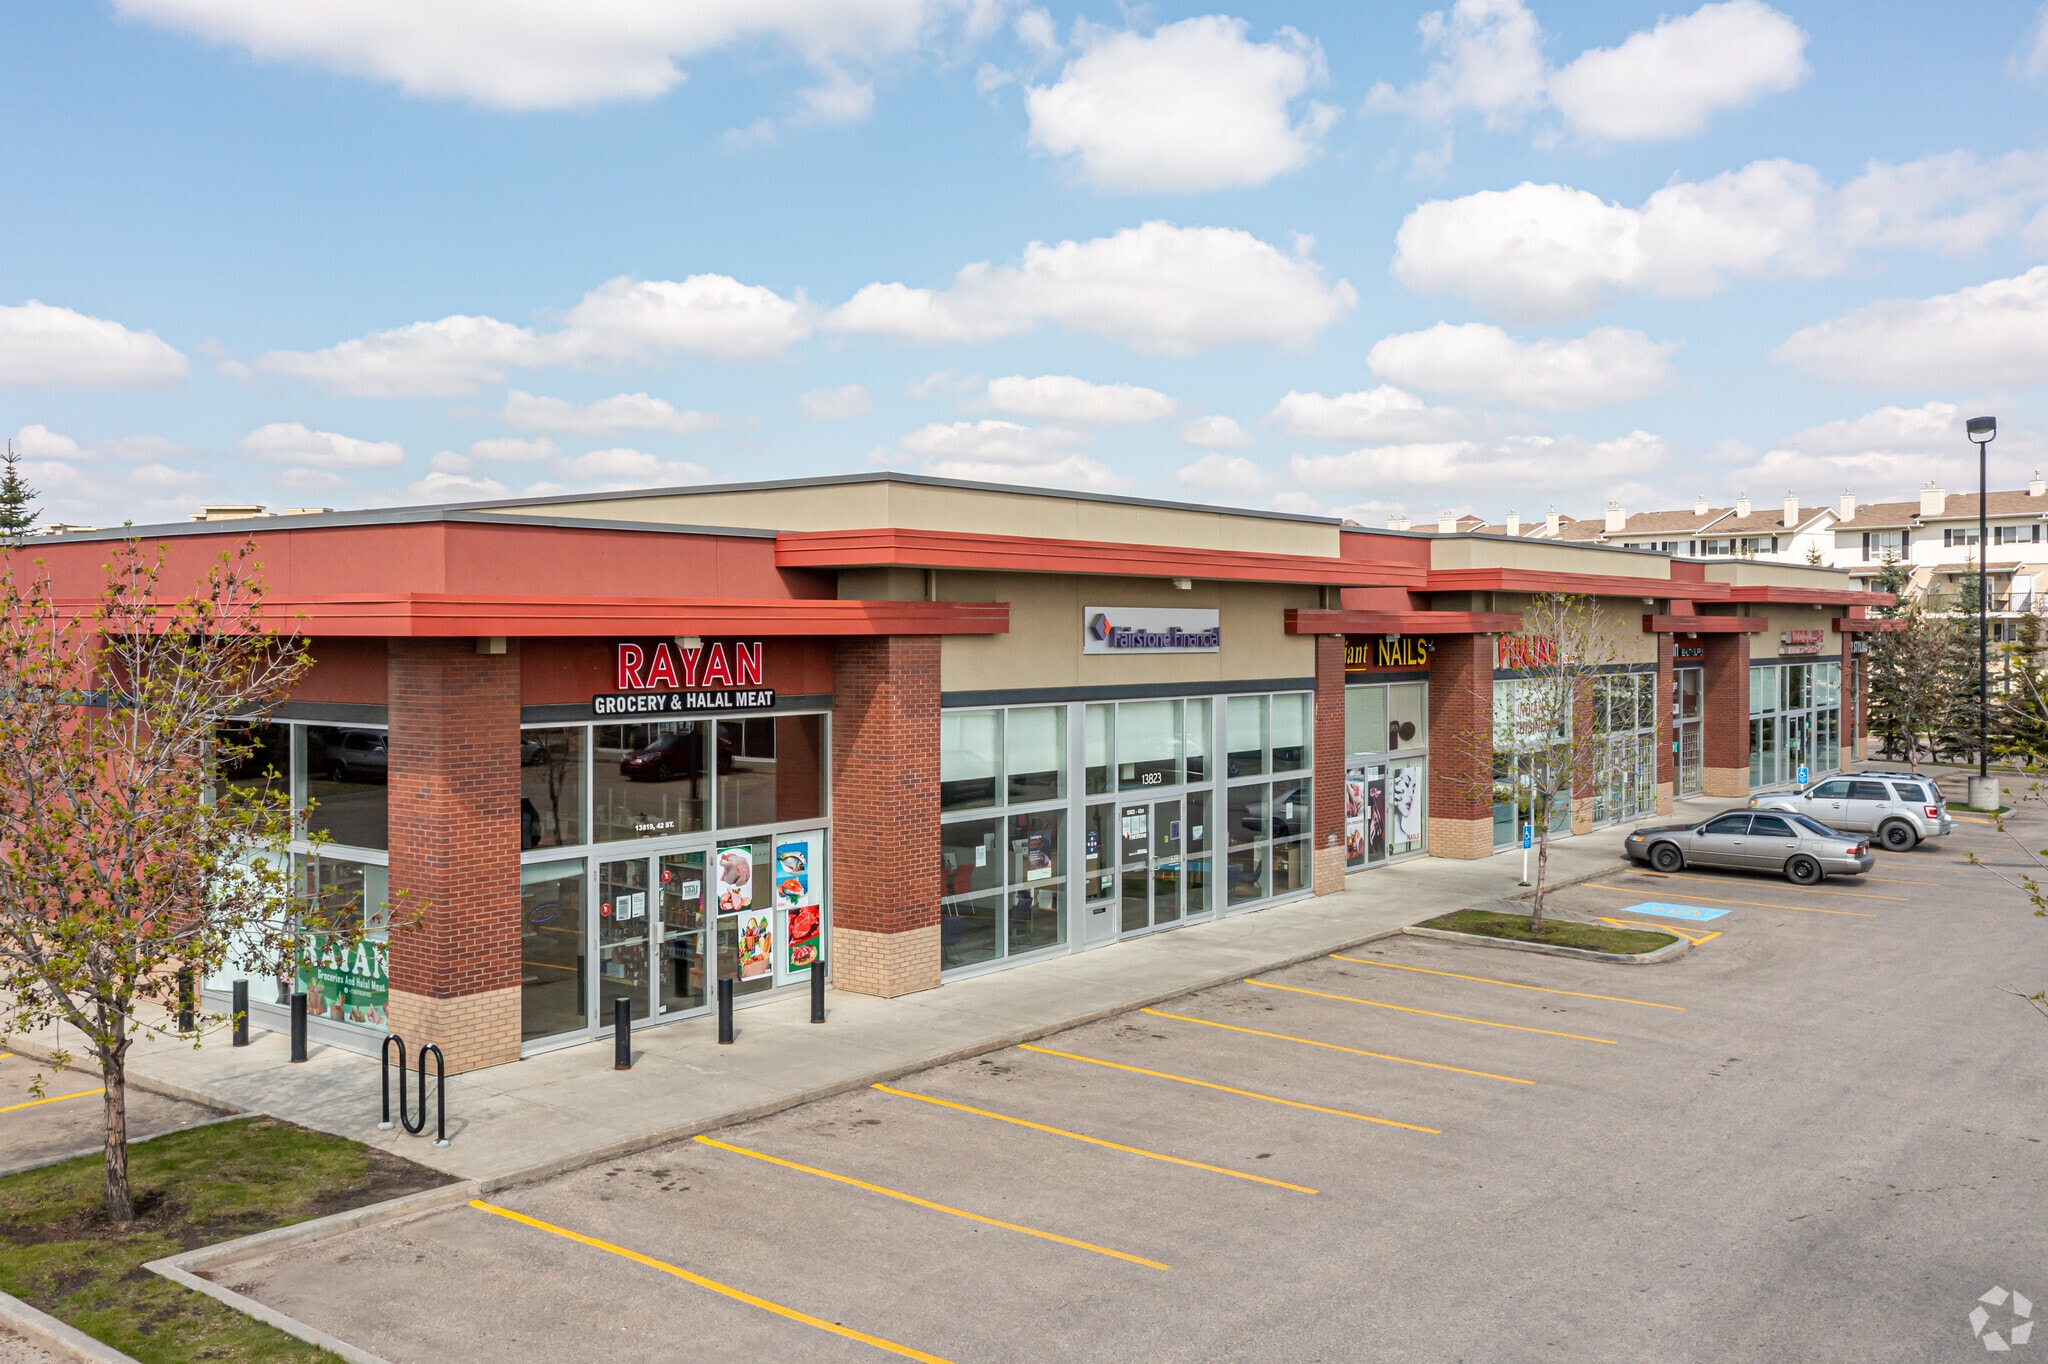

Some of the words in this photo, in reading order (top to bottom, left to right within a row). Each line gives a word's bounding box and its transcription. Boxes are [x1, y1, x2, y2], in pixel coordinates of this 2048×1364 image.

[1110, 627, 1171, 648] Fairstone
[1379, 638, 1427, 667] NAILS
[617, 642, 763, 690] RAYAN
[595, 695, 666, 714] GROCERY
[670, 694, 682, 710] &
[686, 691, 732, 709] HALAL
[735, 691, 773, 707] MEAT
[1141, 772, 1162, 785] 13823
[634, 823, 656, 832] 13819,
[665, 821, 675, 829] ST.
[1406, 832, 1421, 841] NAILS
[317, 969, 344, 984] Groceries
[345, 975, 355, 986] And
[356, 977, 370, 989] Halal
[371, 980, 386, 992] Meat
